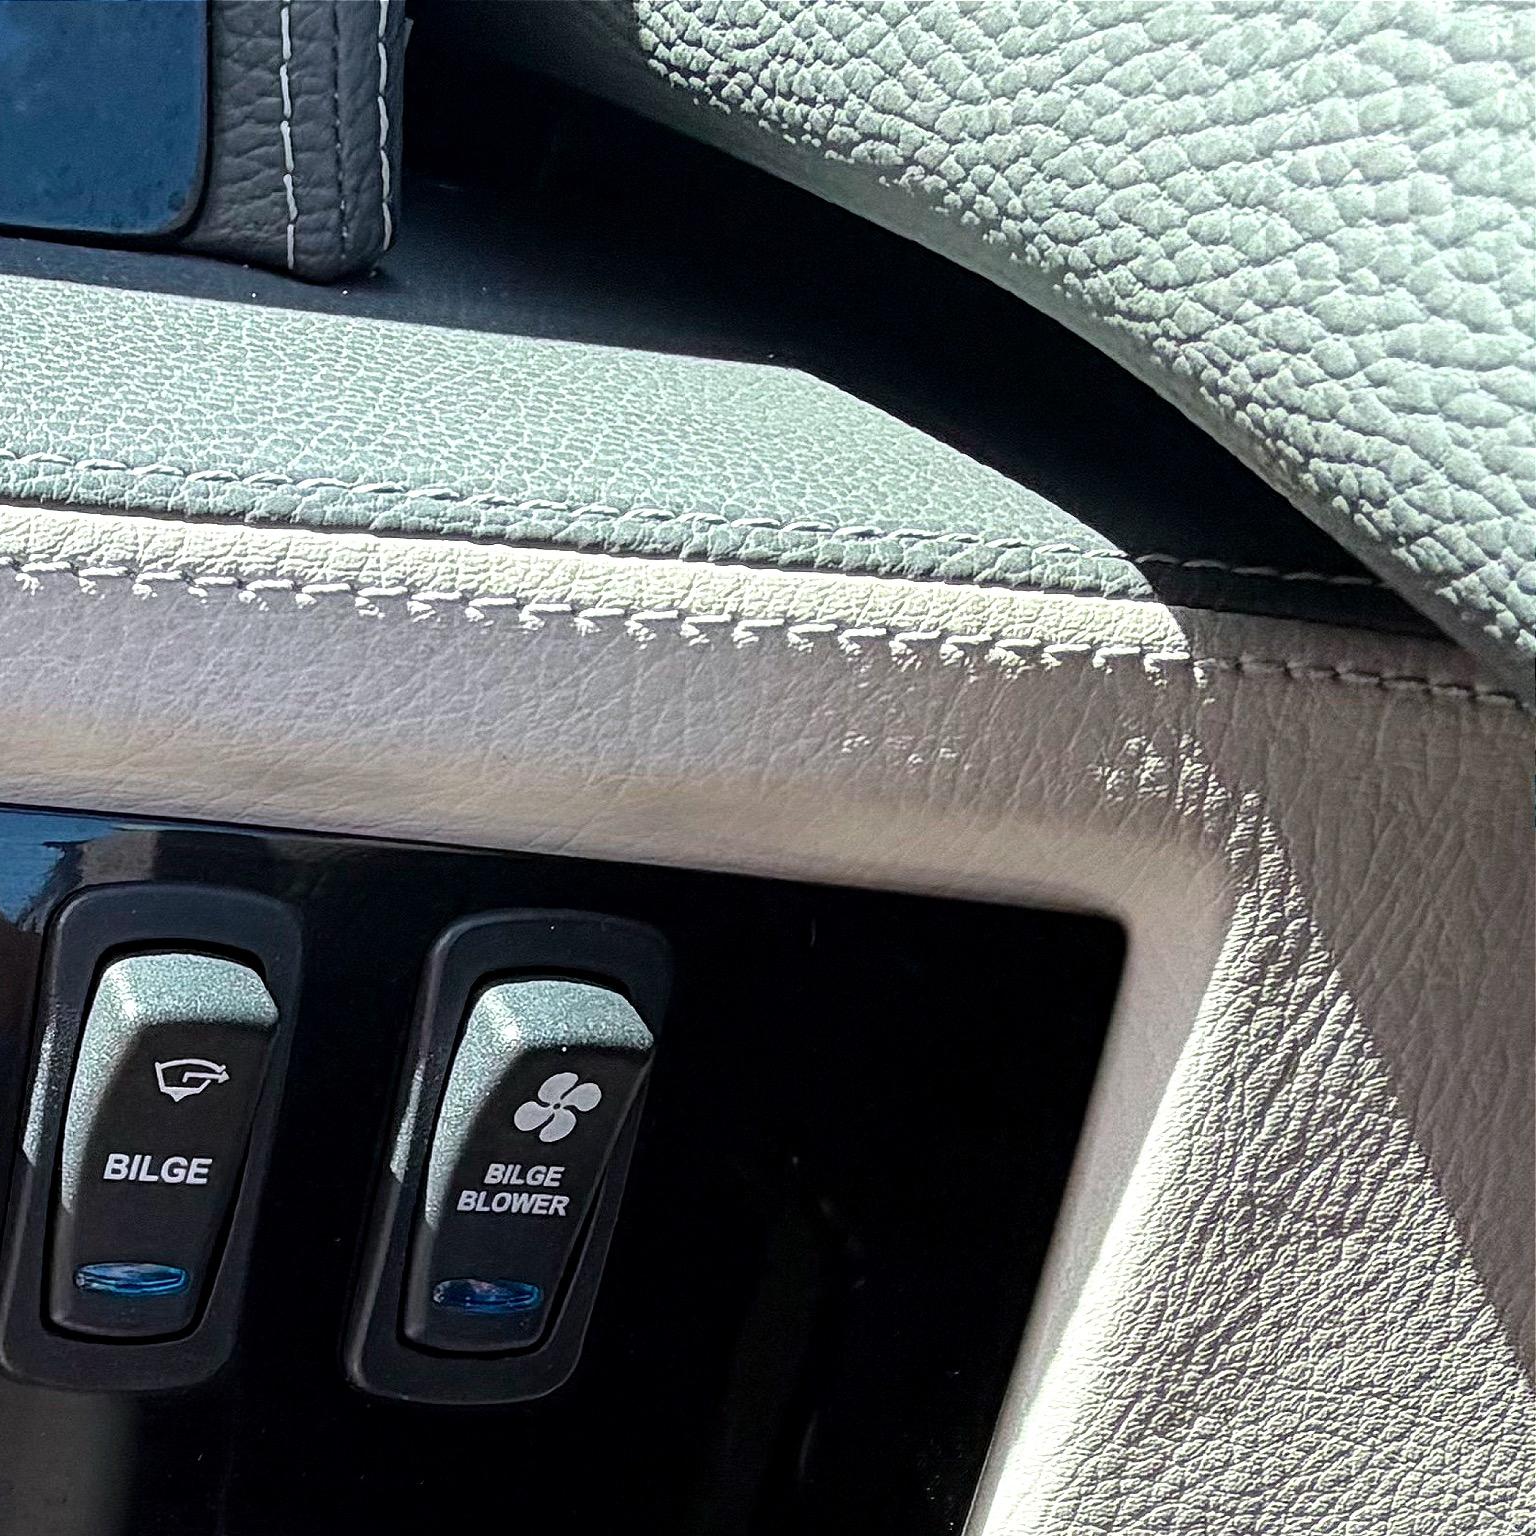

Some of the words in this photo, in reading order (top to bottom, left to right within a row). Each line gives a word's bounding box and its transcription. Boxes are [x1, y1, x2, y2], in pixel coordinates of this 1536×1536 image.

[103, 1153, 213, 1184] BILGE
[483, 1163, 565, 1187] BILGE
[456, 1190, 570, 1216] BLOWER
